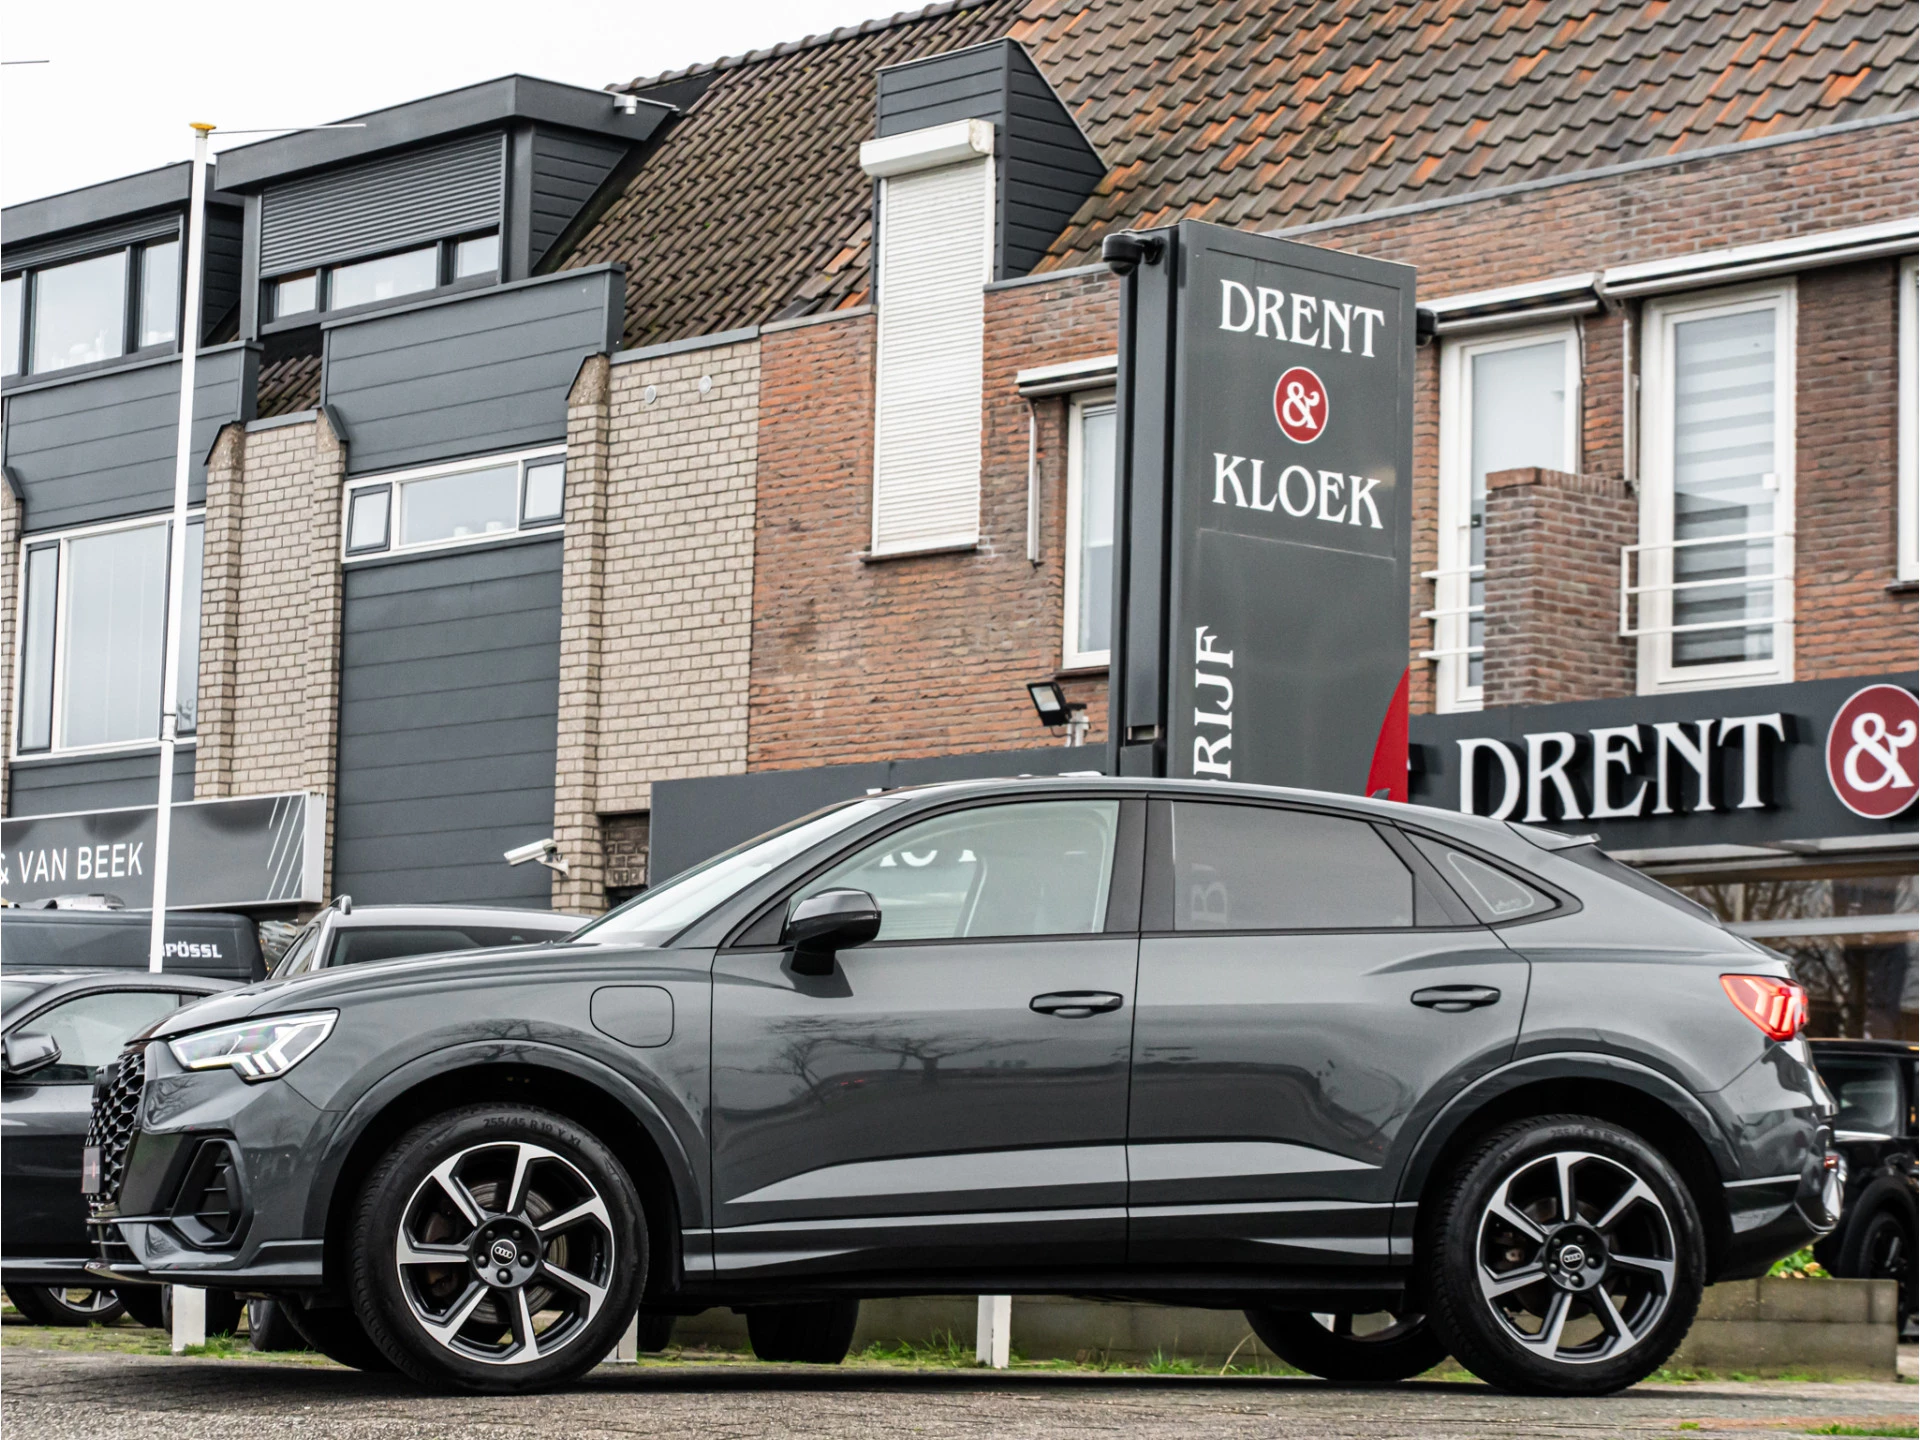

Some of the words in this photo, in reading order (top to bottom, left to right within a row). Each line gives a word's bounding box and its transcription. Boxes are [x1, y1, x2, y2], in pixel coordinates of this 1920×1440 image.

[1219, 279, 1385, 358] DRENT
[1282, 381, 1319, 429] &
[1212, 452, 1383, 529] KLOEK
[1456, 712, 1785, 823] DRENT
[1843, 712, 1917, 793] &
[19, 848, 68, 884] VAN
[77, 842, 143, 880] BEEK
[165, 941, 223, 958] PÖSSL
